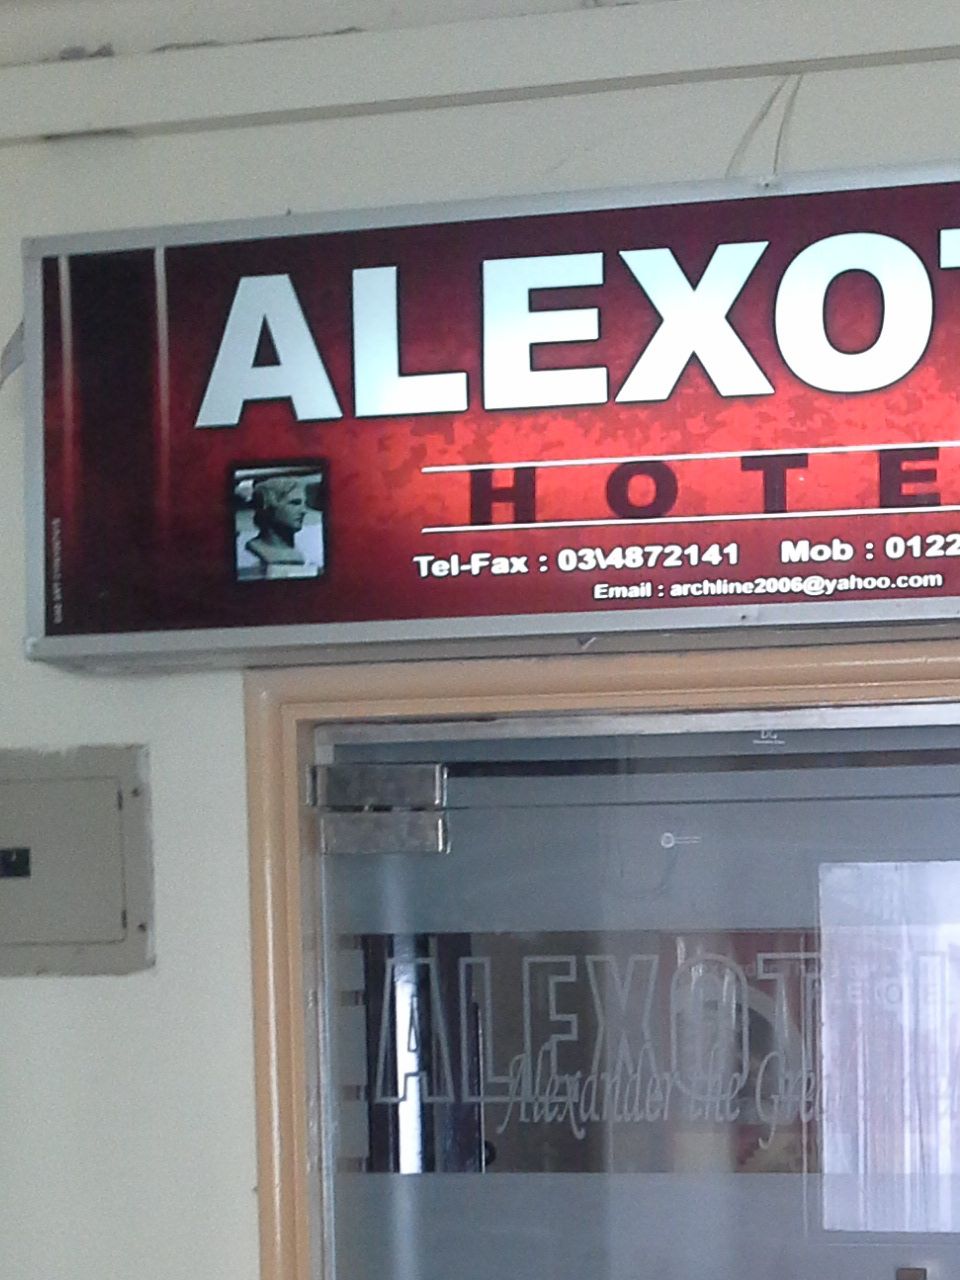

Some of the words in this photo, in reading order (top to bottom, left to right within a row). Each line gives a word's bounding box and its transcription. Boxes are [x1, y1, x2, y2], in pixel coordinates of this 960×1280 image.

[413, 553, 529, 578] Tel-Fax
[557, 543, 738, 572] 03\4872141
[780, 540, 853, 563] Mob
[593, 581, 651, 600] Email
[669, 573, 943, 597] archline2006@yahoo.com
[374, 953, 948, 1103] ALEXOT
[496, 1040, 678, 1140] Alexander
[755, 1049, 824, 1149] Gre
